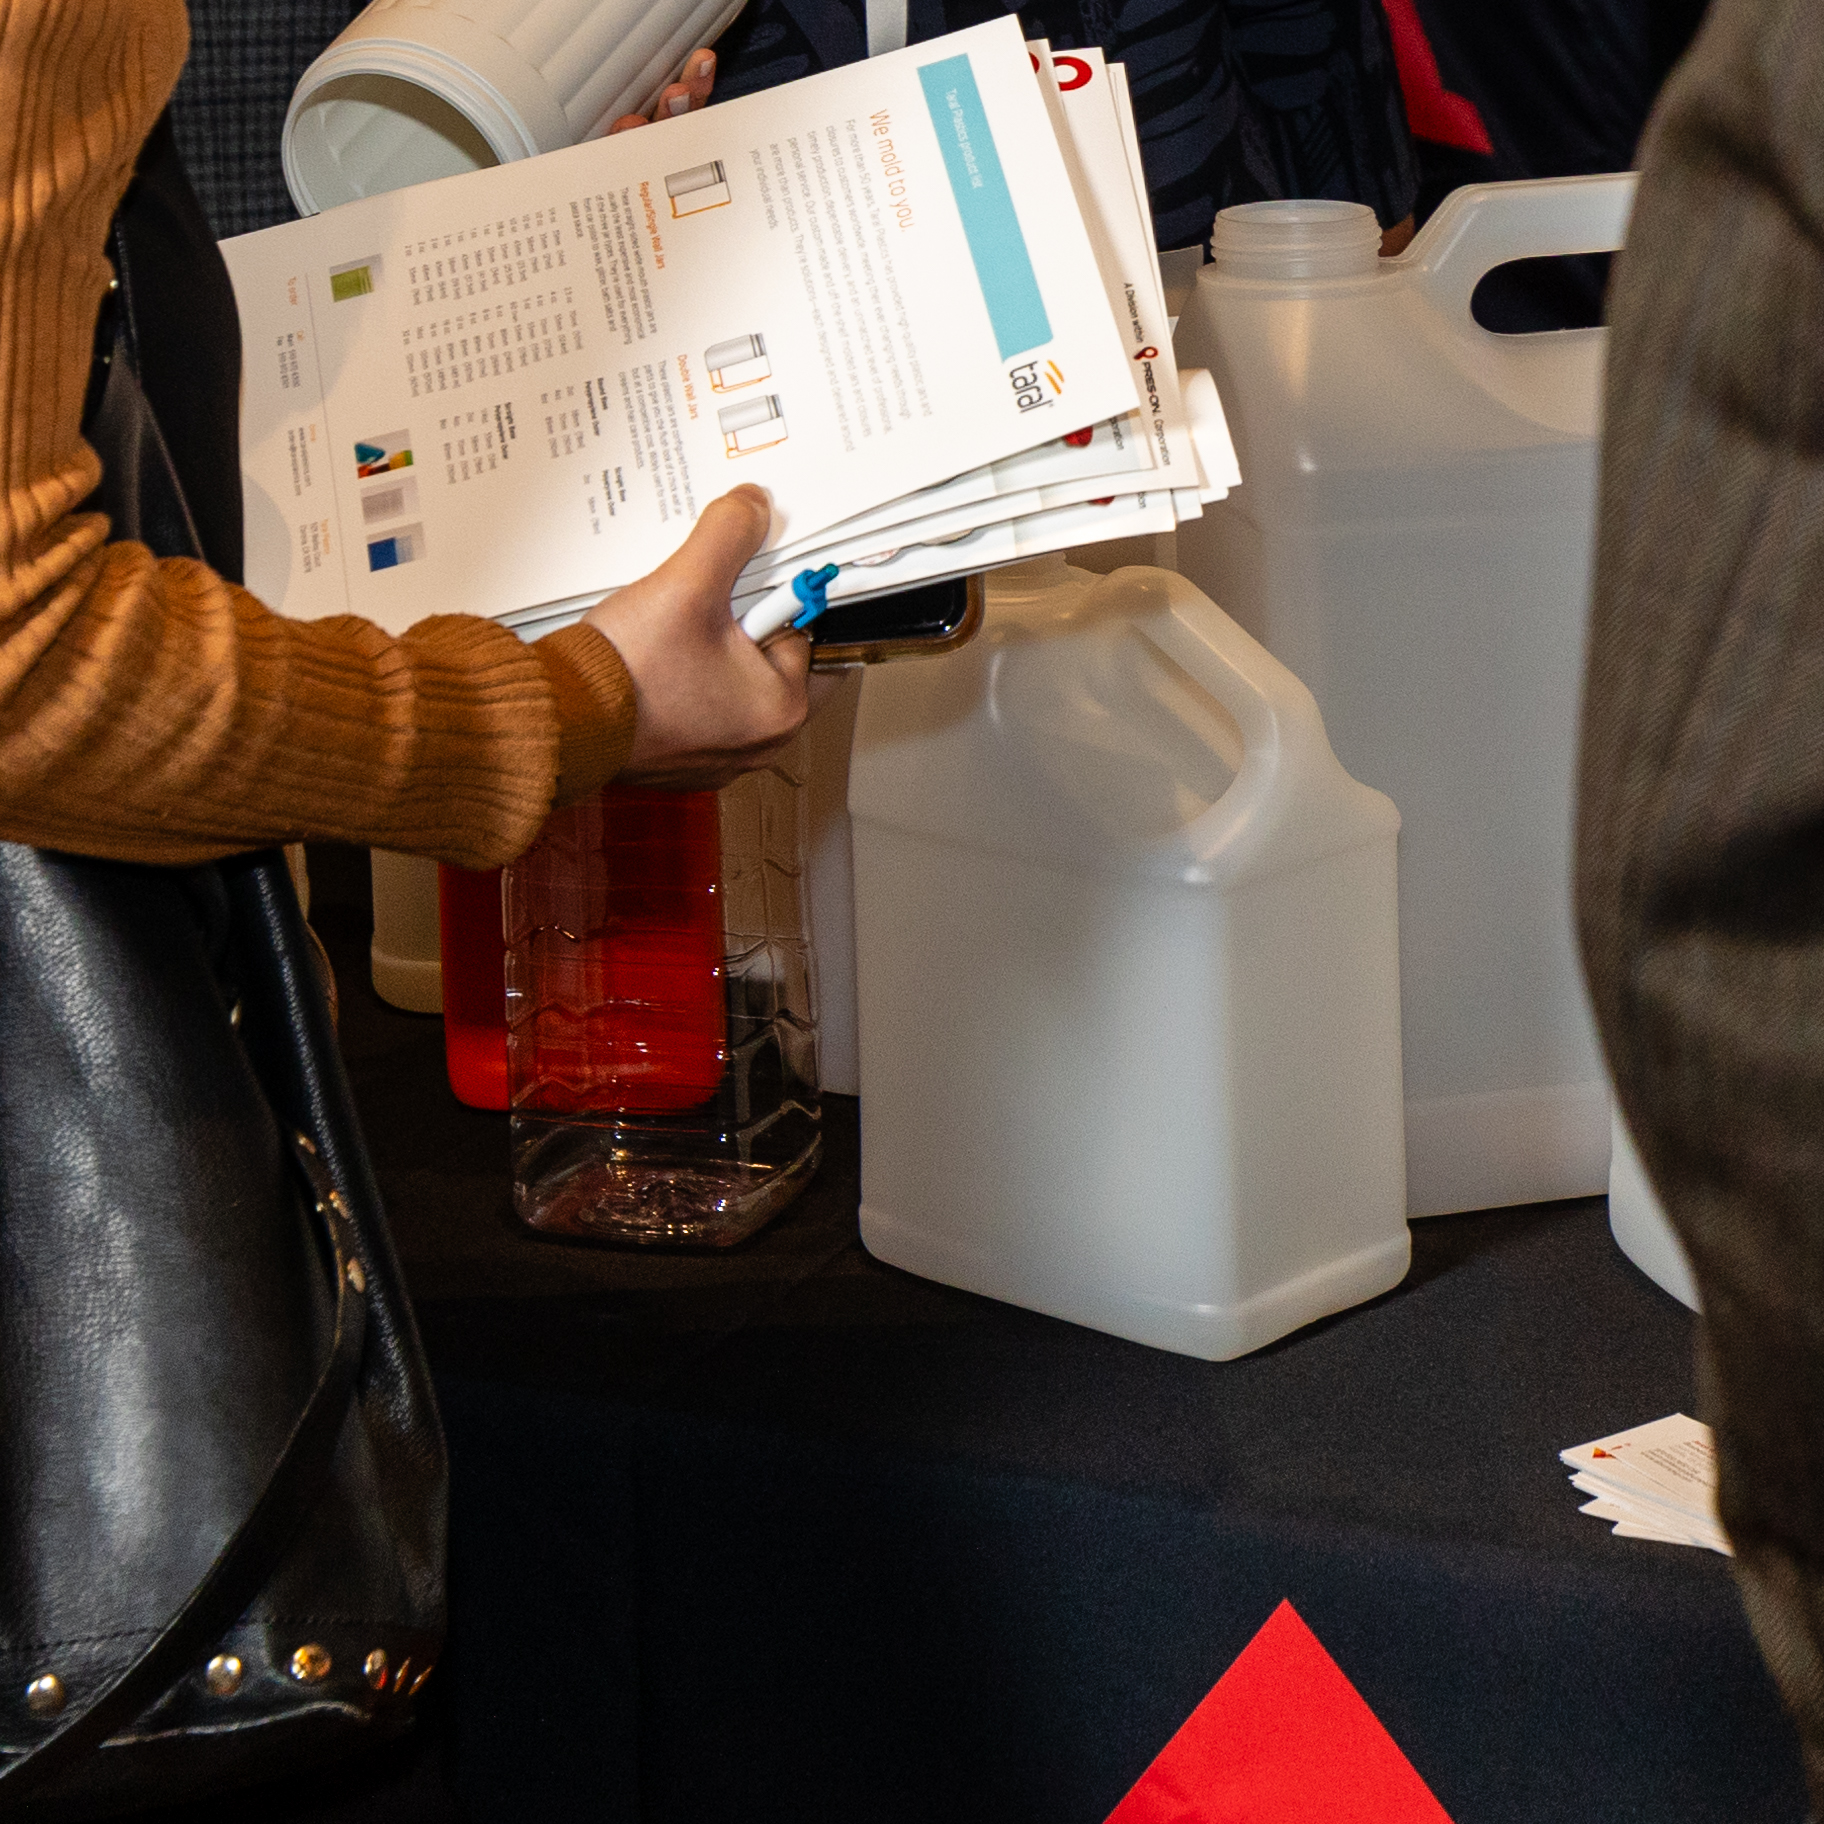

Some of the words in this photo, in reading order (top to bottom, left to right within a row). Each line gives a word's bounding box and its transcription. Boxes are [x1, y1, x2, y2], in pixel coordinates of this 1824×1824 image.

[944, 88, 961, 110] Taral
[844, 118, 856, 132] For
[866, 108, 892, 137] We
[950, 108, 970, 142] Plastics
[768, 142, 781, 156] are
[824, 124, 842, 156] closures
[848, 132, 862, 153] more
[748, 148, 762, 166] your
[772, 156, 786, 176] more
[852, 152, 866, 172] than
[874, 137, 905, 177] mold
[958, 140, 980, 174] product
[754, 166, 772, 204] individual
[777, 176, 791, 196] than
[835, 166, 855, 208] customers
[885, 177, 908, 197] to
[970, 174, 984, 189] list
[638, 180, 658, 234] Regular/Single
[868, 208, 882, 227] Taral
[888, 198, 918, 233] you.
[650, 234, 663, 252] Wall
[786, 136, 804, 170] personal
[804, 200, 816, 216] Our
[822, 272, 836, 288] and
[840, 340, 856, 370] molded
[792, 234, 808, 264] They're
[805, 129, 820, 154] timely
[824, 199, 844, 245] dependable
[845, 280, 858, 296] and
[852, 308, 874, 354] unmatched
[874, 227, 890, 259] Plastics
[654, 252, 666, 270] Jars
[859, 251, 876, 286] meeting
[867, 285, 881, 304] their
[1125, 289, 1139, 319] Division
[872, 305, 886, 323] ever
[1131, 319, 1144, 343] within
[816, 330, 834, 368] designed
[676, 353, 691, 382] Double
[683, 383, 696, 402] Wall
[1009, 360, 1052, 413] taral
[686, 402, 700, 420] Jars
[1152, 418, 1171, 466] Corporation
